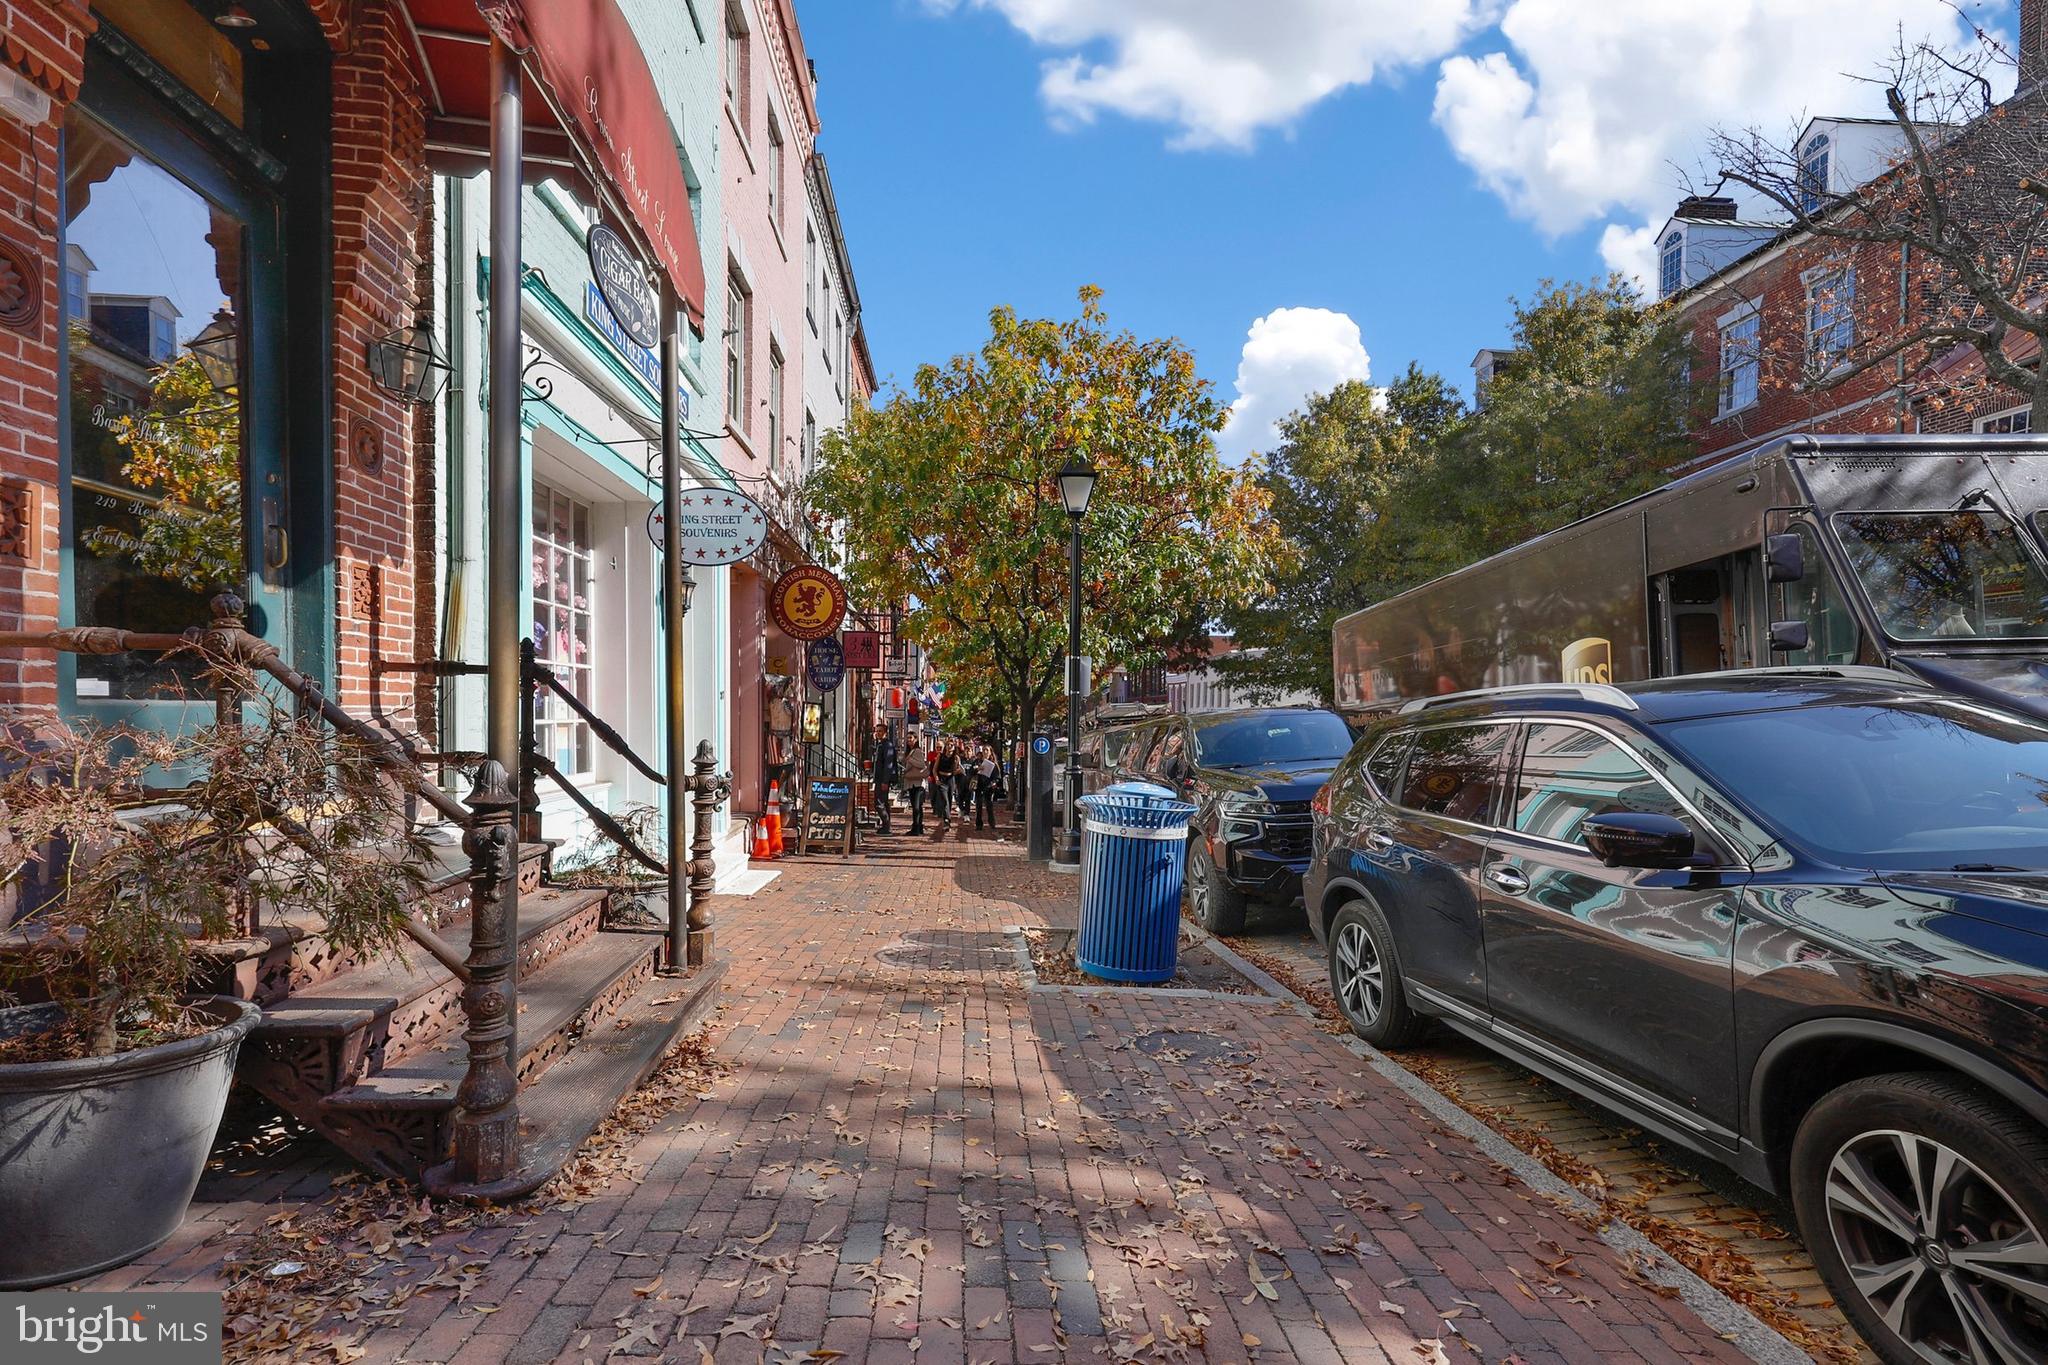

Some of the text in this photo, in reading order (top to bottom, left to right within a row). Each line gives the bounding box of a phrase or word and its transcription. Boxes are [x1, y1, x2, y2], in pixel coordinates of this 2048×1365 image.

[621, 146, 648, 214] Street
[600, 246, 632, 294] CIGAR
[633, 277, 652, 326] BAR
[591, 290, 648, 374] KING STREET
[95, 494, 117, 509] 219
[680, 528, 738, 538] SOUVENIRS
[681, 515, 742, 524] ING STREET
[92, 525, 157, 555] Entrance
[165, 549, 180, 558] on
[775, 569, 844, 607] SCOTTISH MERCHANT
[776, 614, 840, 639] TOBACCONIST
[810, 812, 846, 824] CIGARS
